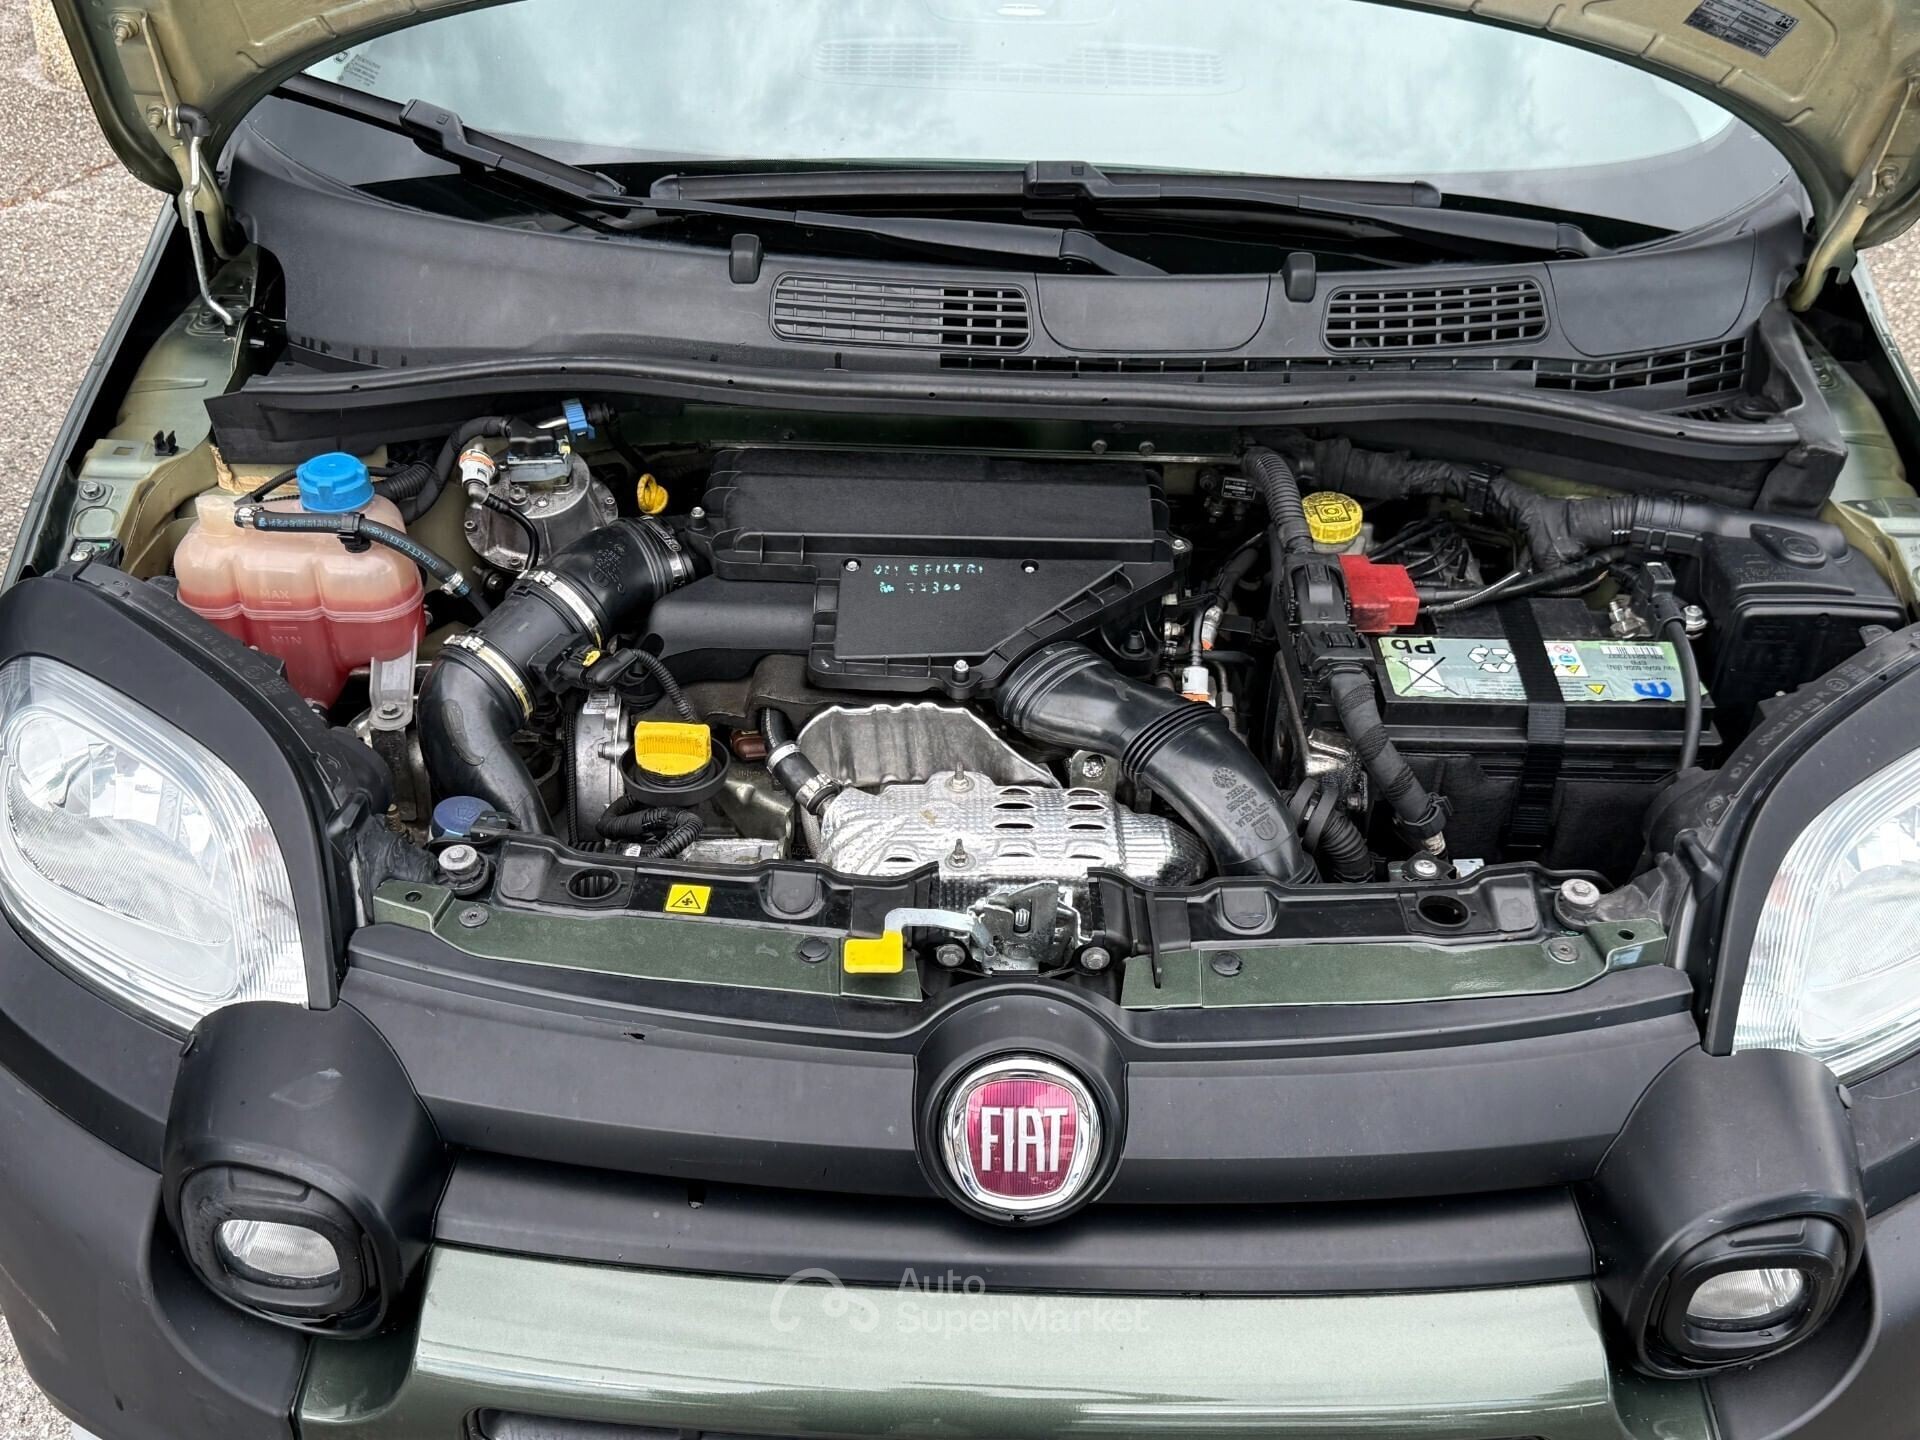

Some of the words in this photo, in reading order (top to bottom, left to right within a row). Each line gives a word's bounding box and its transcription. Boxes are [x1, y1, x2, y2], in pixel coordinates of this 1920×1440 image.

[260, 589, 289, 600] MAX
[271, 634, 303, 645] MIN
[1390, 639, 1436, 654] Pb
[980, 1106, 1068, 1172] FIAT
